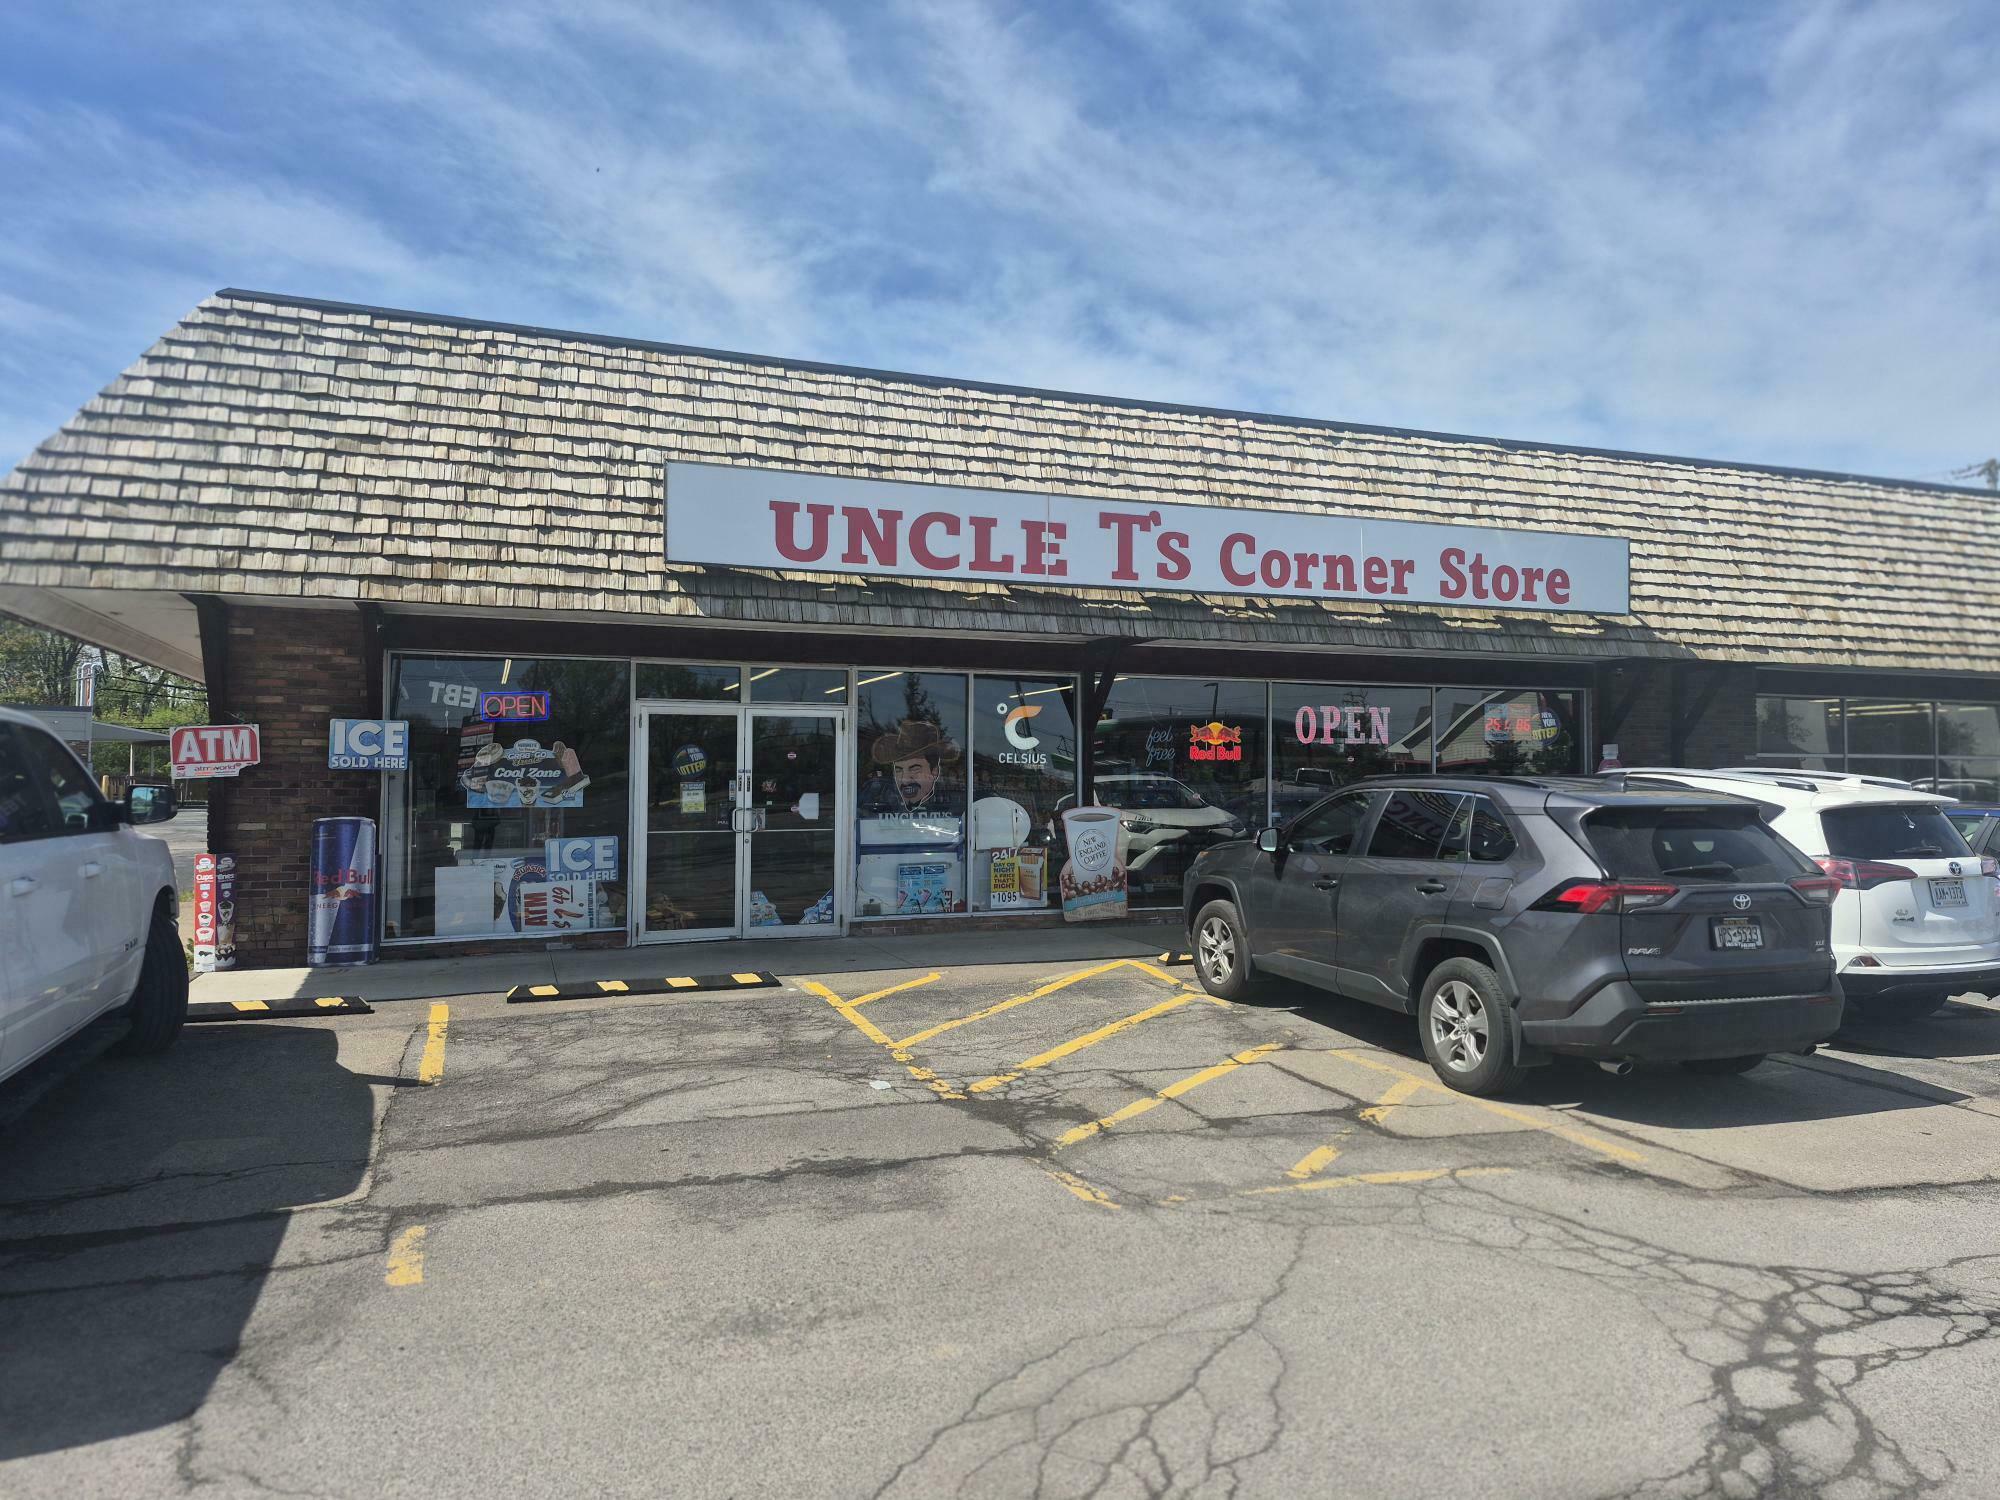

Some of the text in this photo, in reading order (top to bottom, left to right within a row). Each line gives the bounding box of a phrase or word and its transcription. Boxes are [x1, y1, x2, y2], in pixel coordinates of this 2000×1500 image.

[769, 500, 1571, 605] UNCLE T's Corner Store
[484, 696, 546, 717] OPEN
[1295, 705, 1391, 744] OPEN
[177, 729, 252, 762] ATM
[333, 721, 405, 756] ICE
[1145, 725, 1174, 748] feel
[331, 756, 406, 769] SOLD HERE
[998, 752, 1047, 764] CELSIUS
[1146, 746, 1176, 767] free
[1189, 745, 1242, 760] Red Bull
[494, 767, 561, 778] Cool Zone
[549, 838, 616, 871] ICE
[344, 869, 373, 885] Bull
[586, 870, 617, 880] HERE
[523, 891, 548, 927] ATM
